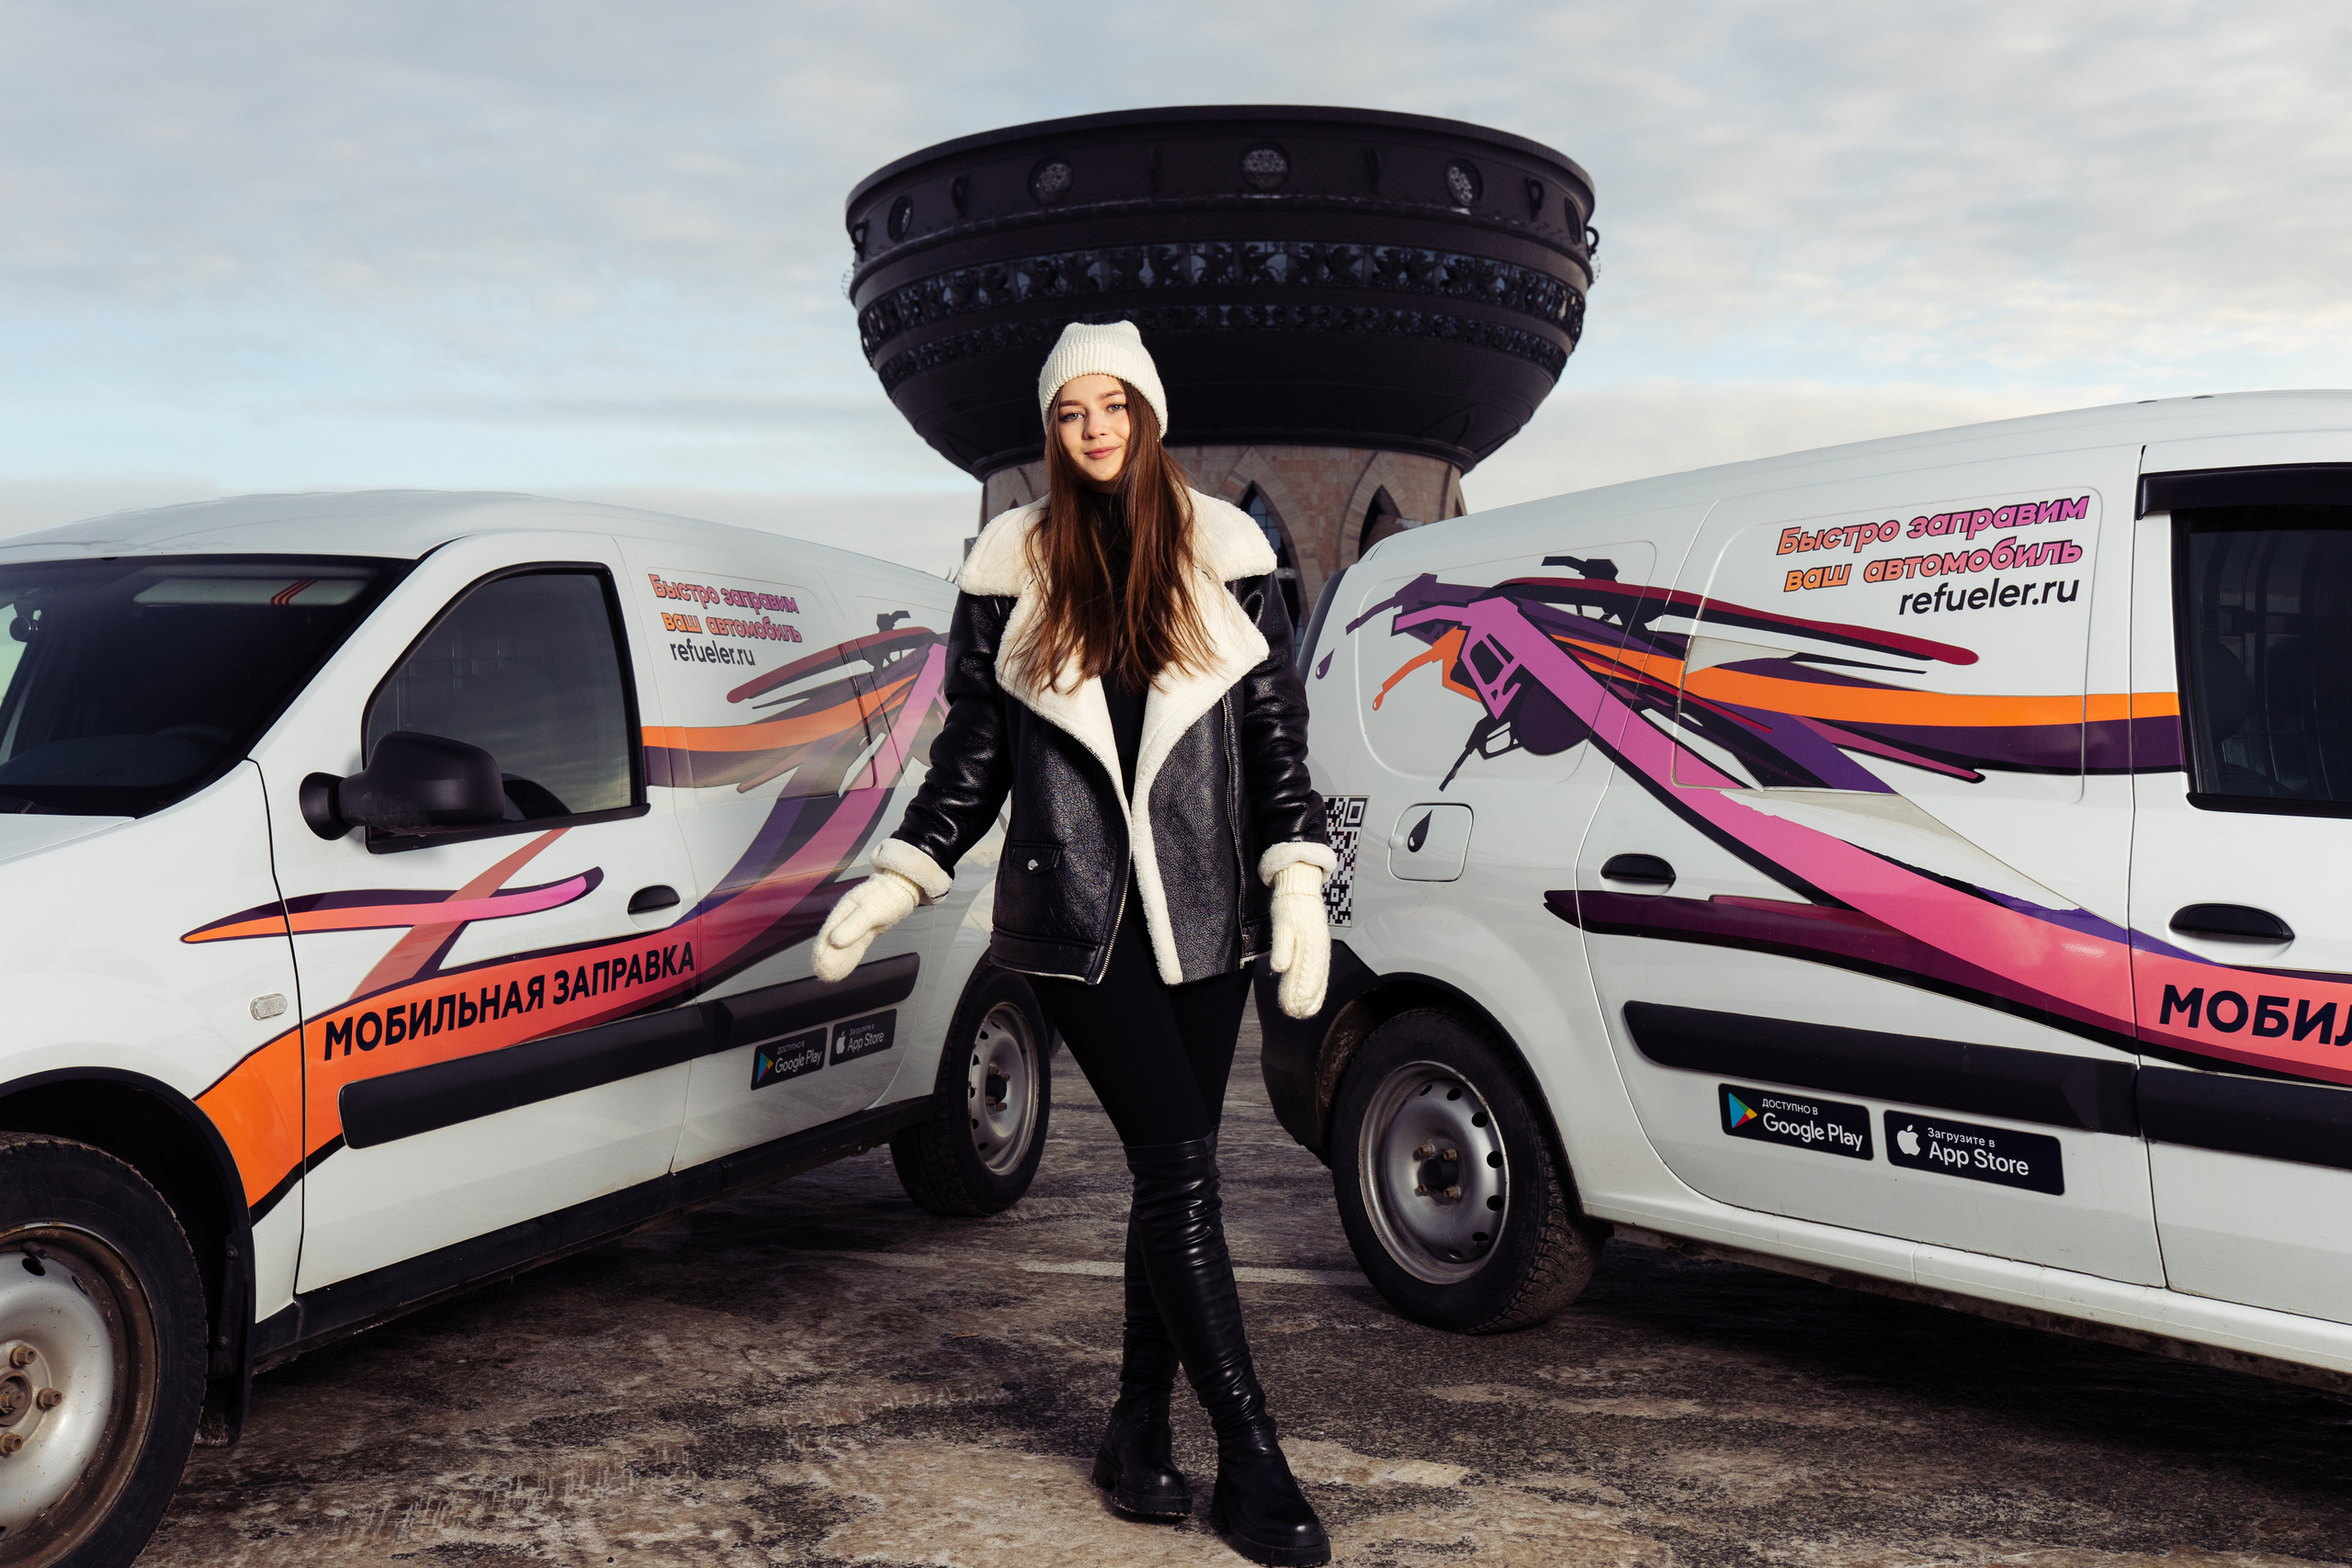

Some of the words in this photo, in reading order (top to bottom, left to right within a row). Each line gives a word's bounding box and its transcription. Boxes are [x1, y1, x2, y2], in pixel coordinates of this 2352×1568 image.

[1776, 520, 1900, 556] Быстро
[1906, 495, 2090, 540] заправим
[1783, 563, 1852, 592] ваш
[1863, 536, 2083, 583] автомобиль
[648, 573, 720, 609] Быстро
[720, 588, 800, 615] заправим
[1898, 578, 2080, 615] refueler.ru
[661, 612, 703, 634] ваш
[706, 616, 802, 643] автомобиль
[670, 637, 755, 666] refueler.ru
[323, 975, 545, 1062] МОБИЛЬНАЯ
[552, 942, 695, 1005] ЗАПРАВКА
[847, 1037, 864, 1053] App
[864, 1032, 884, 1047] Store
[775, 1055, 805, 1074] Google
[805, 1048, 822, 1066] Play
[1762, 1099, 1811, 1114] ДОСТУПНО
[1762, 1113, 1825, 1143] Google
[1827, 1123, 1863, 1152] Play
[1928, 1127, 1985, 1145] Загрузите
[1929, 1141, 1969, 1168] App
[1973, 1149, 2030, 1177] Store
